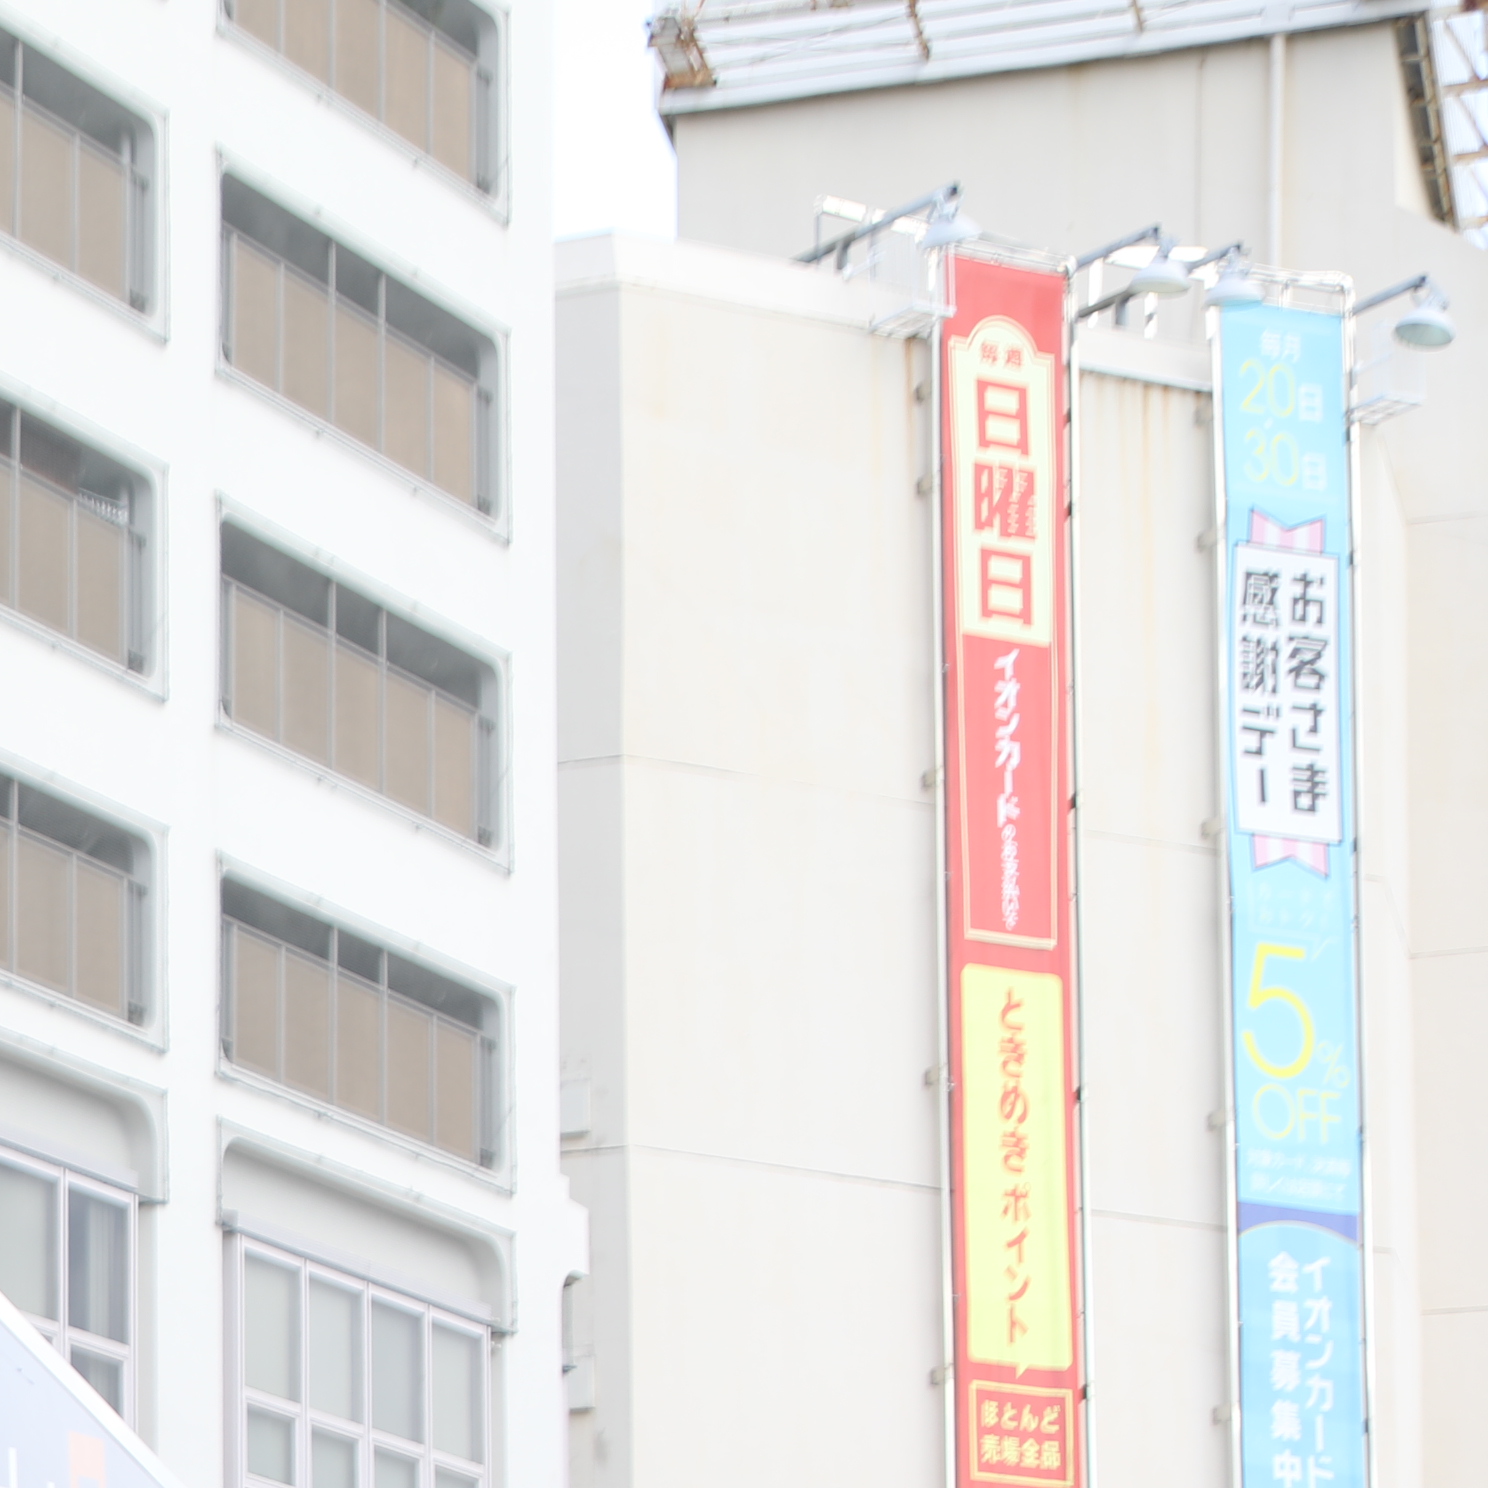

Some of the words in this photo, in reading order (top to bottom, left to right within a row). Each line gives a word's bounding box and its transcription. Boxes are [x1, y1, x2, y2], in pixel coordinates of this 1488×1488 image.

[972, 377, 1039, 628] 日曜日
[1239, 569, 1282, 804] 感謝デー
[1286, 571, 1329, 814] お客さま
[998, 986, 1032, 1346] ときめきポイント
[1252, 1082, 1343, 1144] OFF
[980, 1399, 1062, 1434] ほとんど
[980, 1433, 1062, 1471] 売場全品
